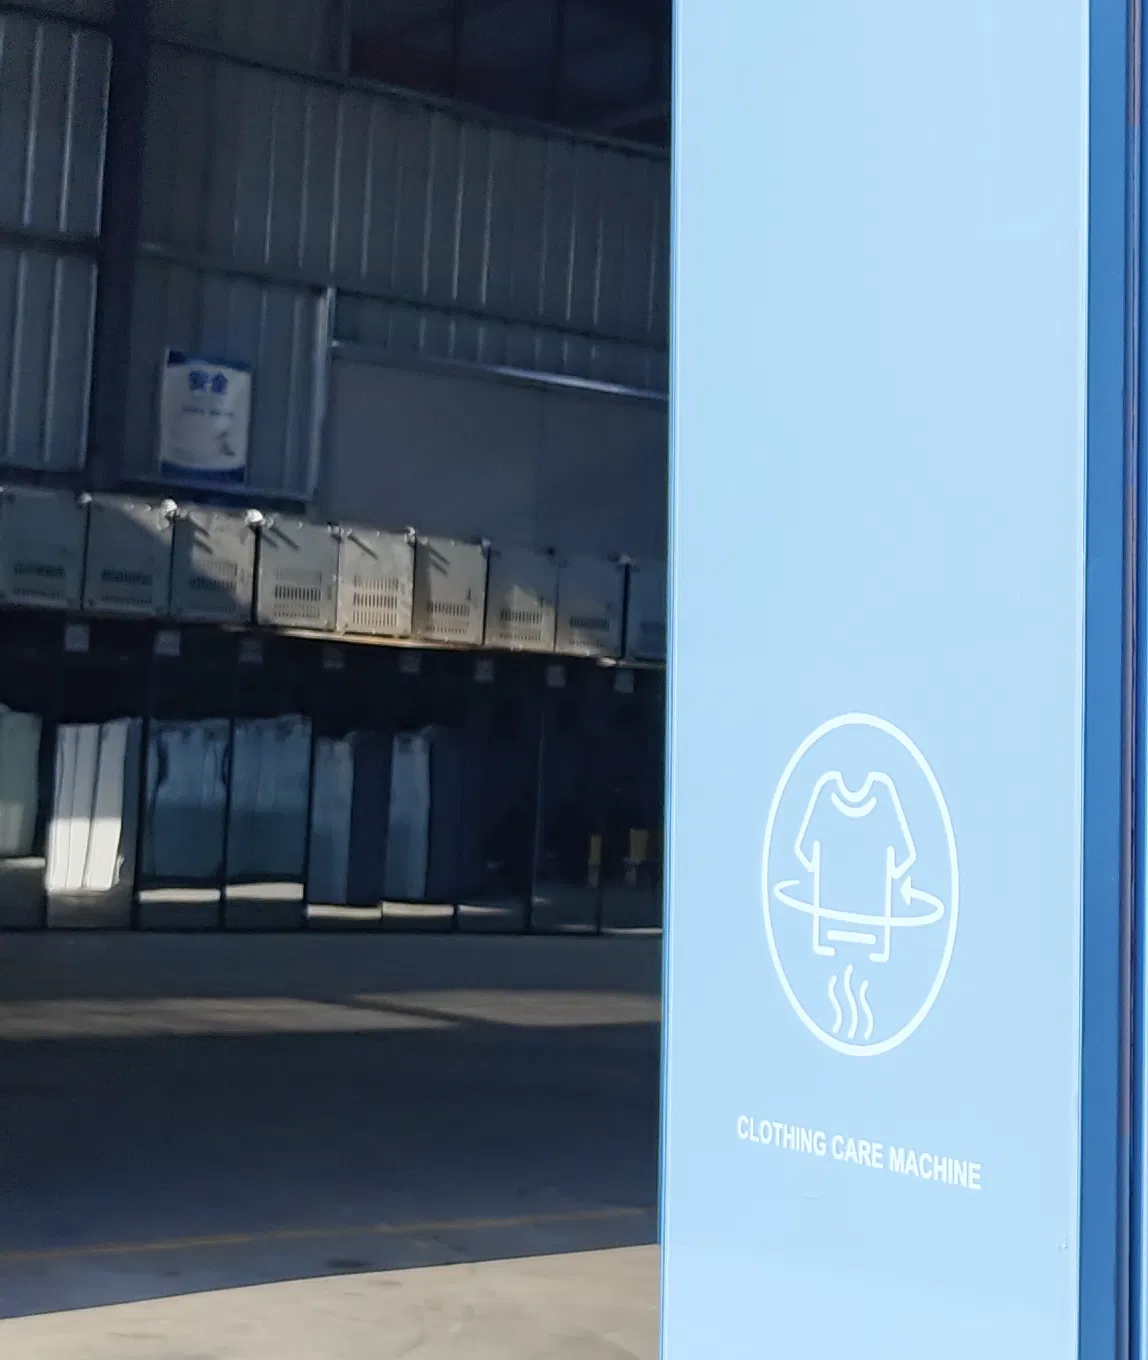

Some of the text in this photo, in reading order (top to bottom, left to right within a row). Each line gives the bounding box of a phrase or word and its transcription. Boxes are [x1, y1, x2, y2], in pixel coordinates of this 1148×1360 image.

[737, 1115, 982, 1190] CLOTHING CARE MACHINE
